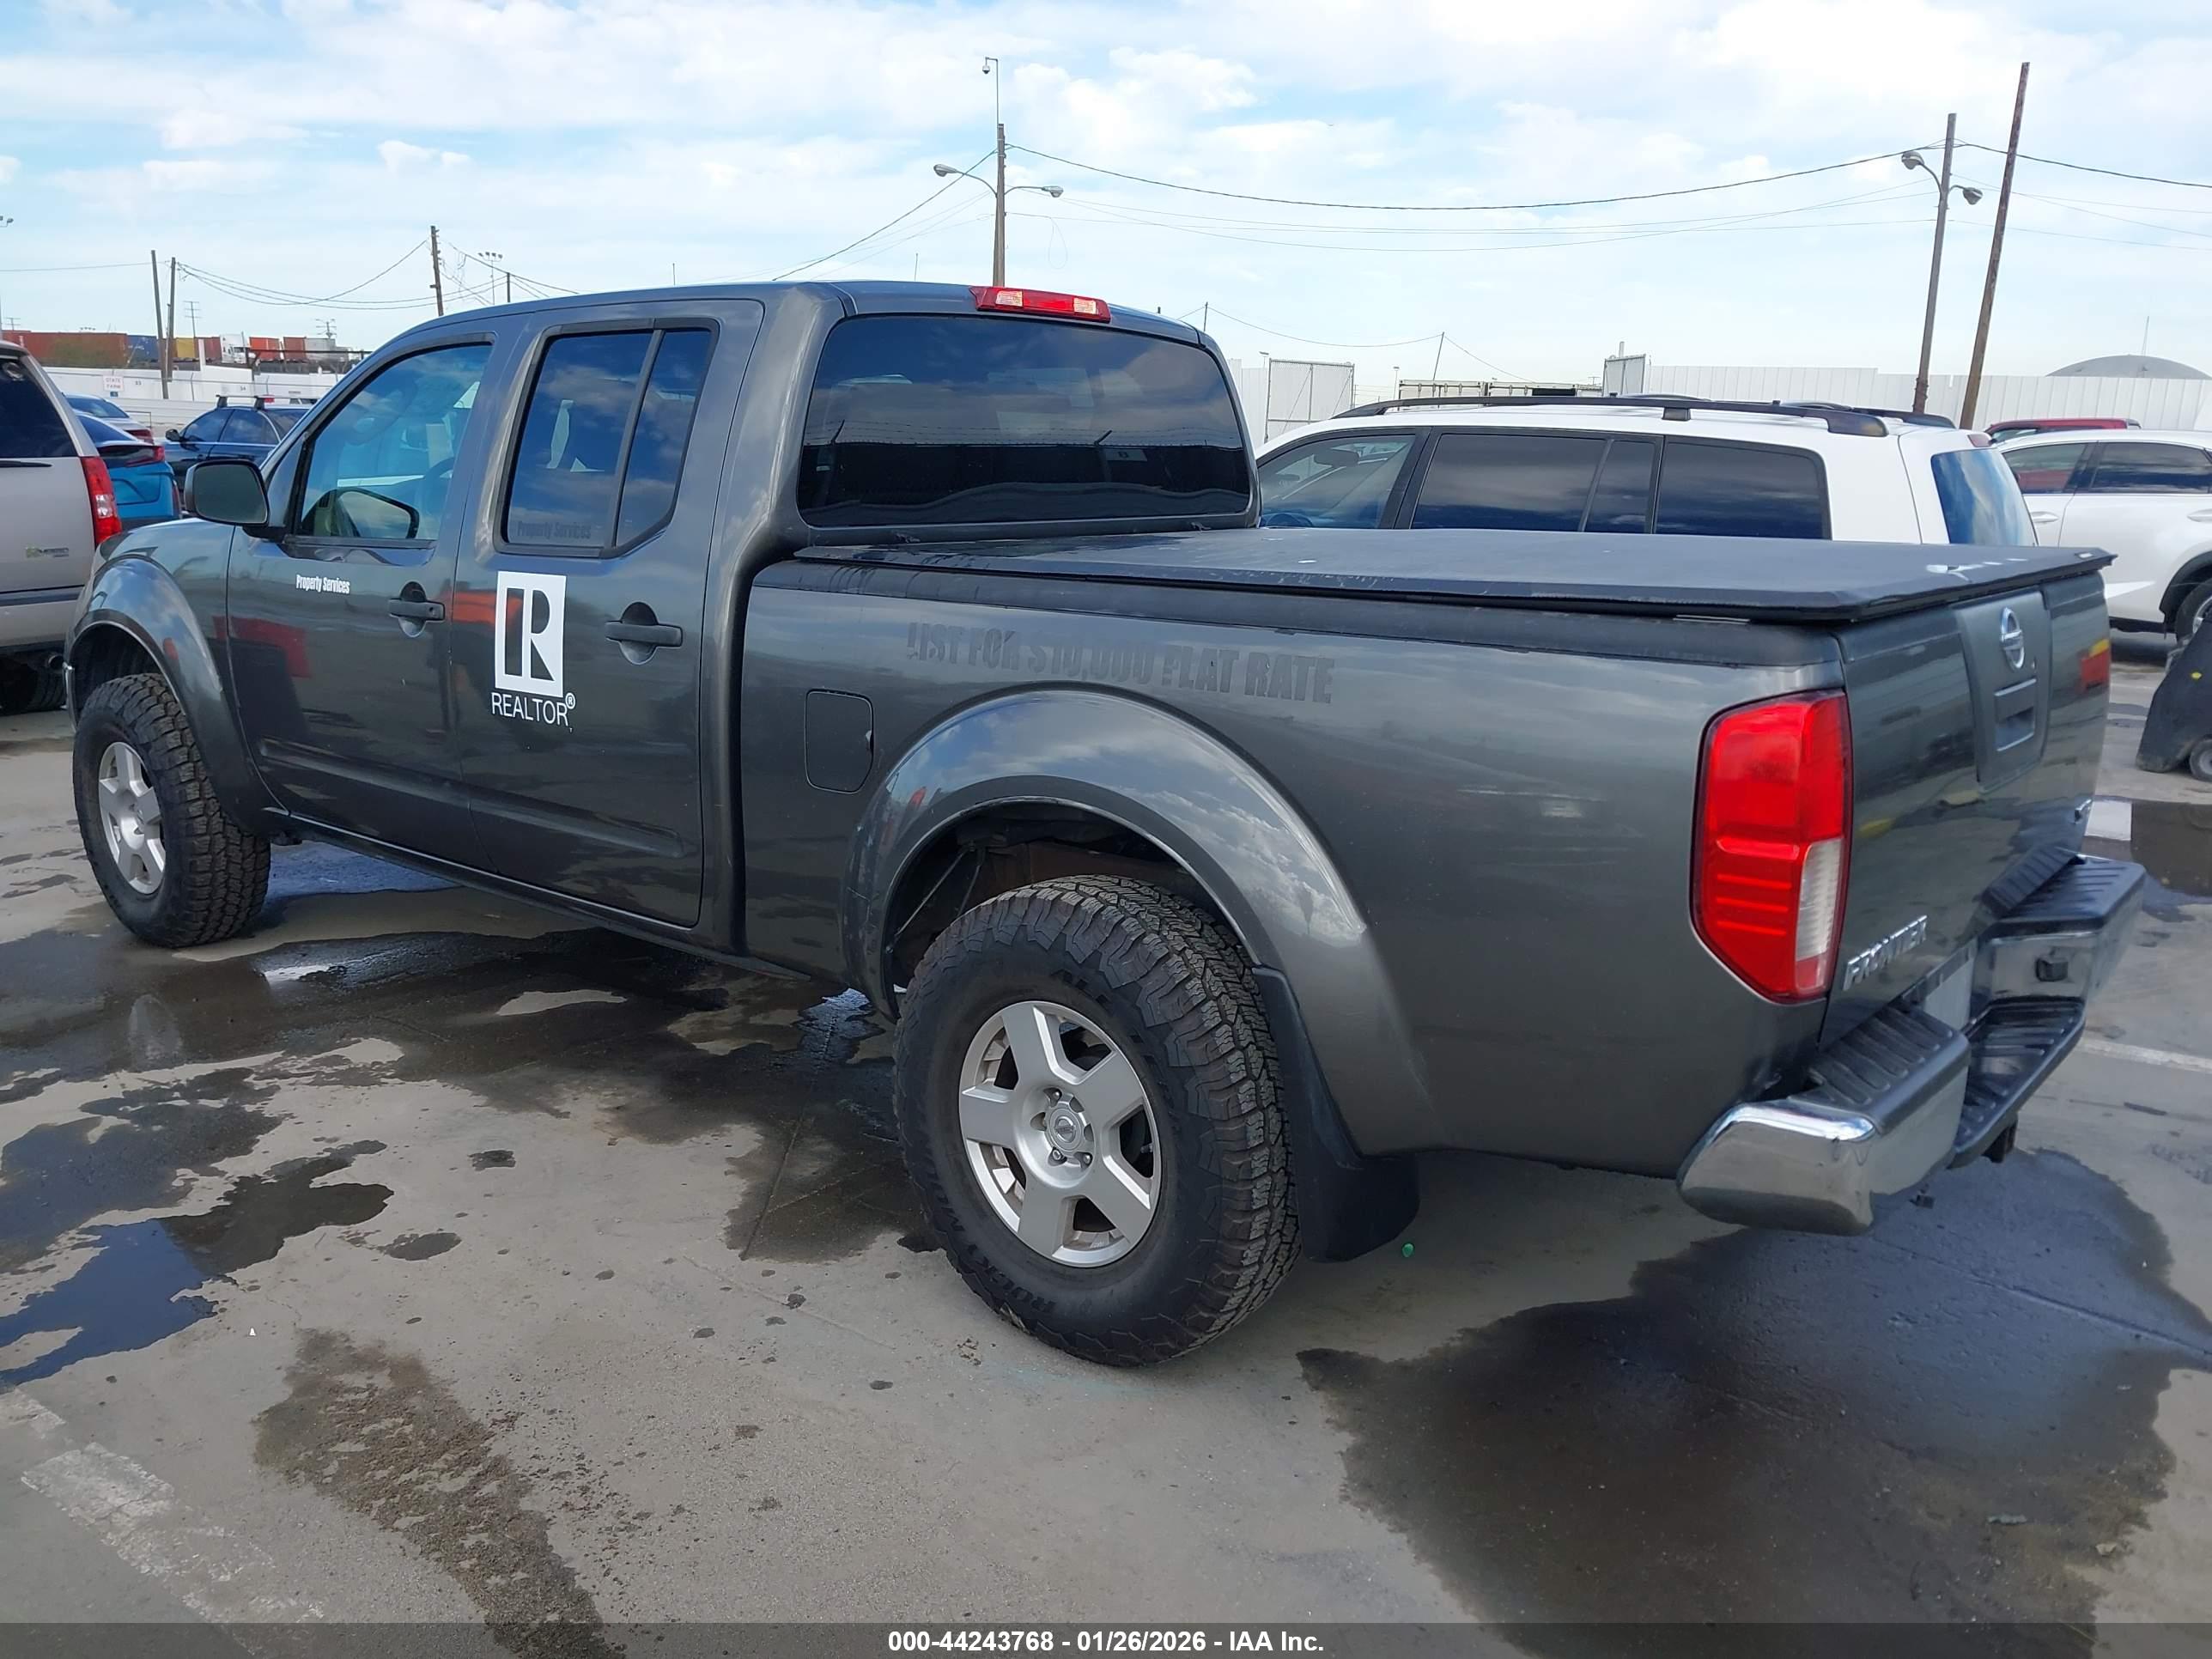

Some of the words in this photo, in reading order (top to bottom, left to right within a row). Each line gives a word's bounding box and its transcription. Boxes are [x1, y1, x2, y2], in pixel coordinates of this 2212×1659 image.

[295, 574, 322, 592] Property
[322, 576, 350, 594] Services
[968, 627, 1021, 671] FOR
[1161, 645, 1241, 694] FLAT
[1245, 652, 1335, 704] RATE
[1843, 915, 1927, 992] FRONTIER
